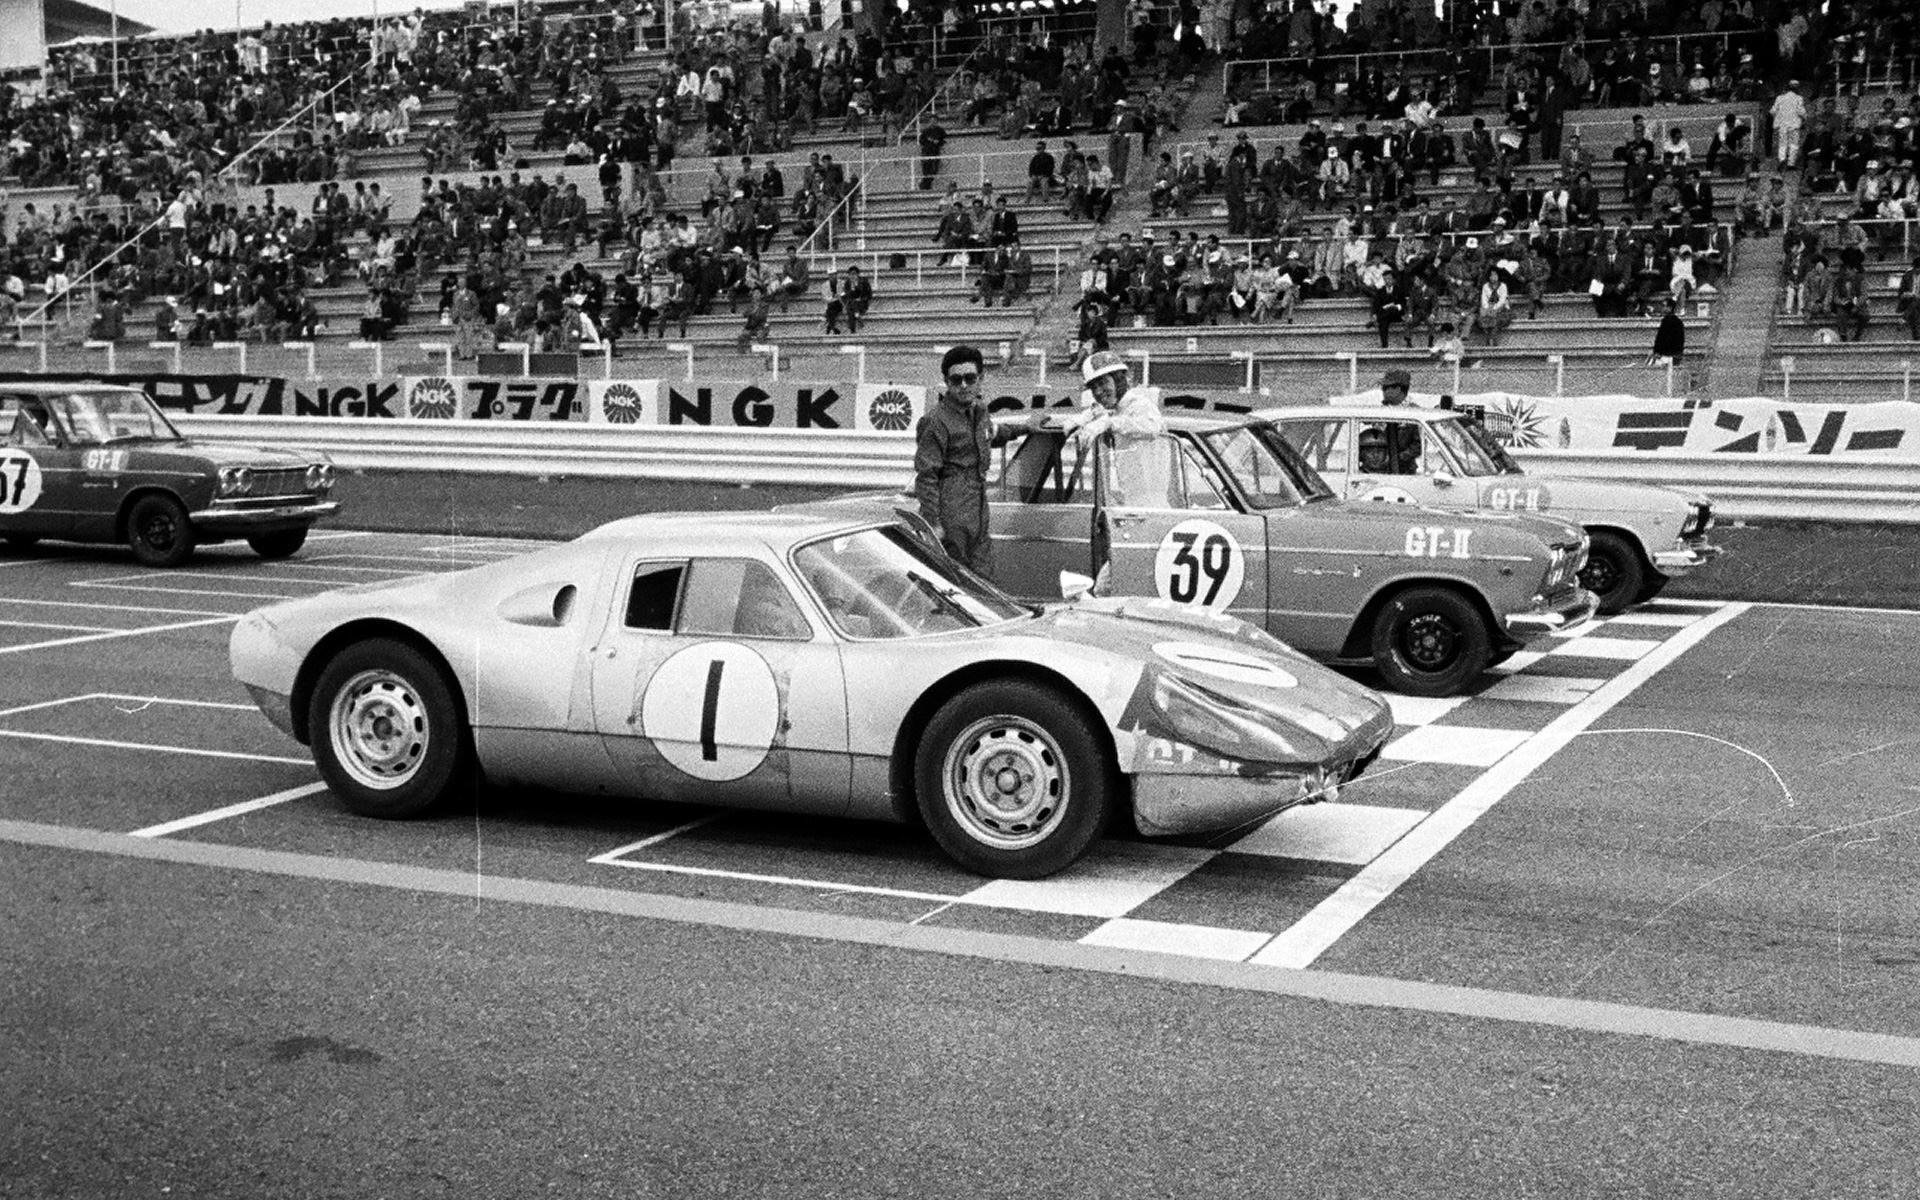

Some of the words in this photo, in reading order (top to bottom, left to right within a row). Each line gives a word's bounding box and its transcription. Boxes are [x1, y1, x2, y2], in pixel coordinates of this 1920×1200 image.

[294, 382, 399, 418] NGK
[413, 389, 451, 404] NGK
[467, 381, 583, 421] プラグ
[608, 394, 638, 408] NGK
[669, 385, 840, 429] NGK
[875, 402, 906, 415] NGK
[1170, 531, 1232, 606] 39
[700, 659, 725, 761] 1
